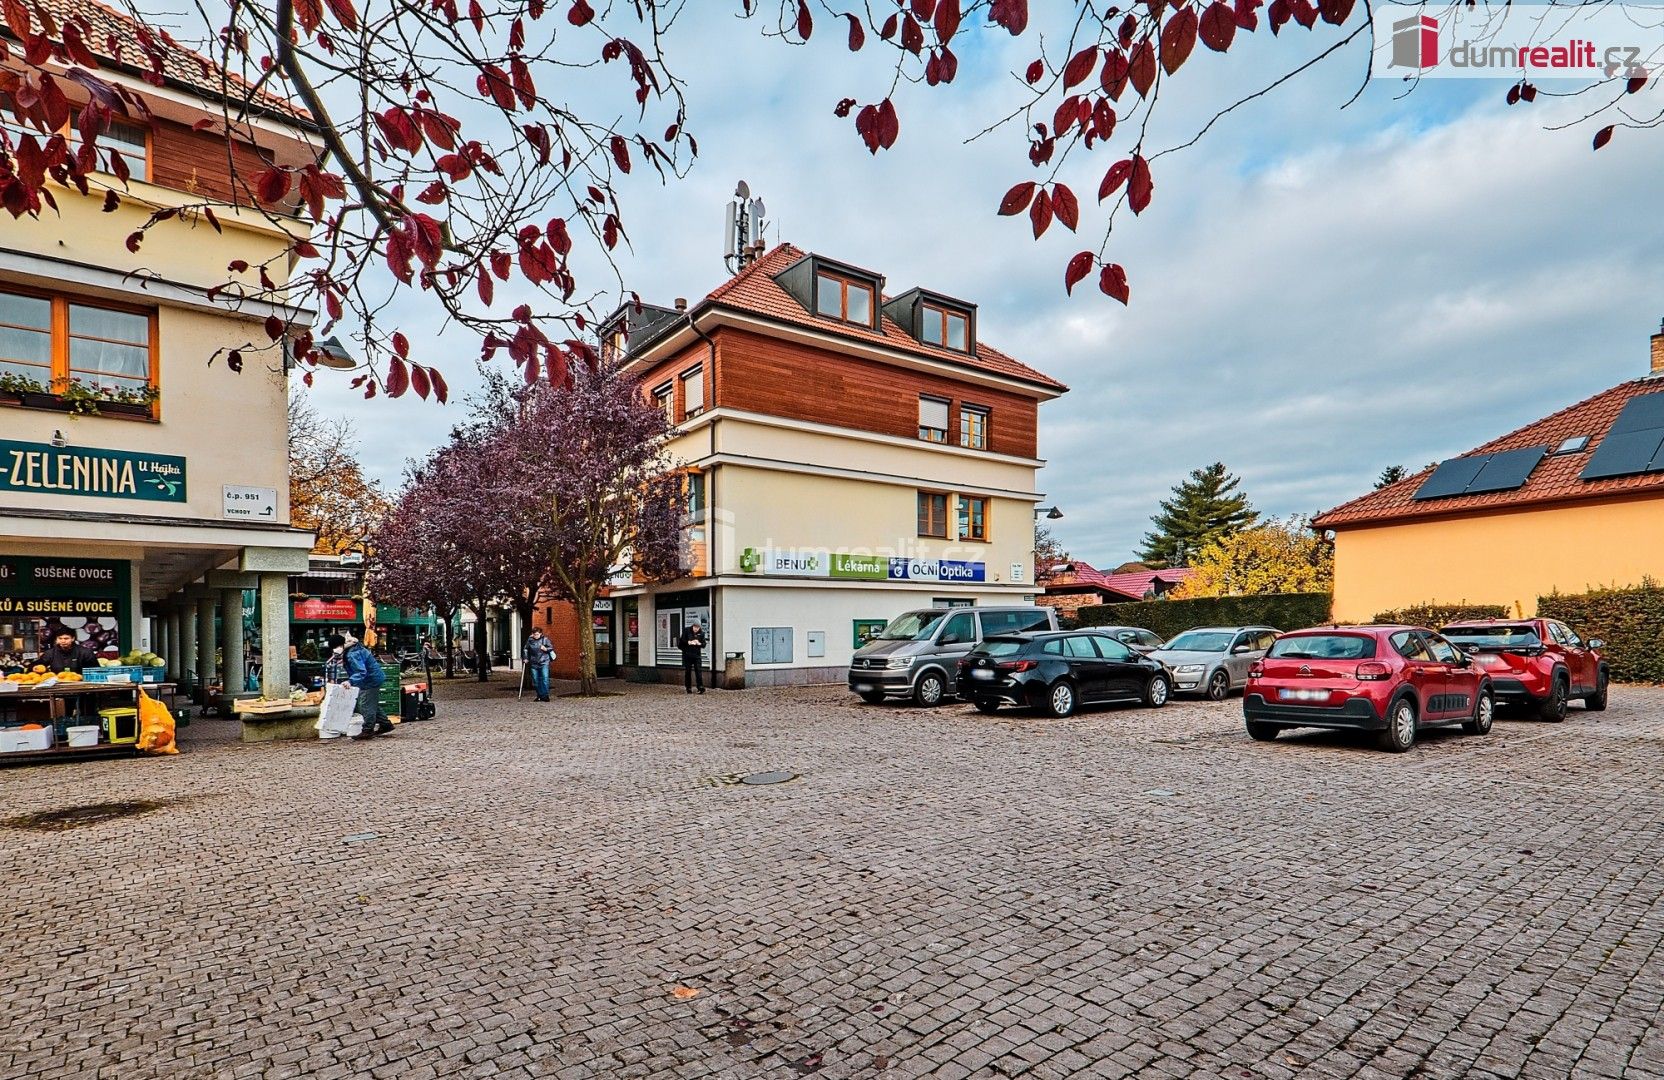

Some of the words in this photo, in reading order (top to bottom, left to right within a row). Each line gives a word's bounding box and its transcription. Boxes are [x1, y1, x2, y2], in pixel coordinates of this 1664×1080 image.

[138, 460, 148, 472] U
[245, 493, 260, 501] 951
[775, 558, 807, 571] BENU
[838, 558, 880, 574] Lékárna
[34, 566, 77, 579] SUŠENÉ
[79, 568, 113, 579] OVOCE
[940, 564, 973, 580] Optika
[15, 601, 24, 612] A
[27, 599, 74, 612] SUŠENÉ
[76, 601, 113, 613] OVOCE
